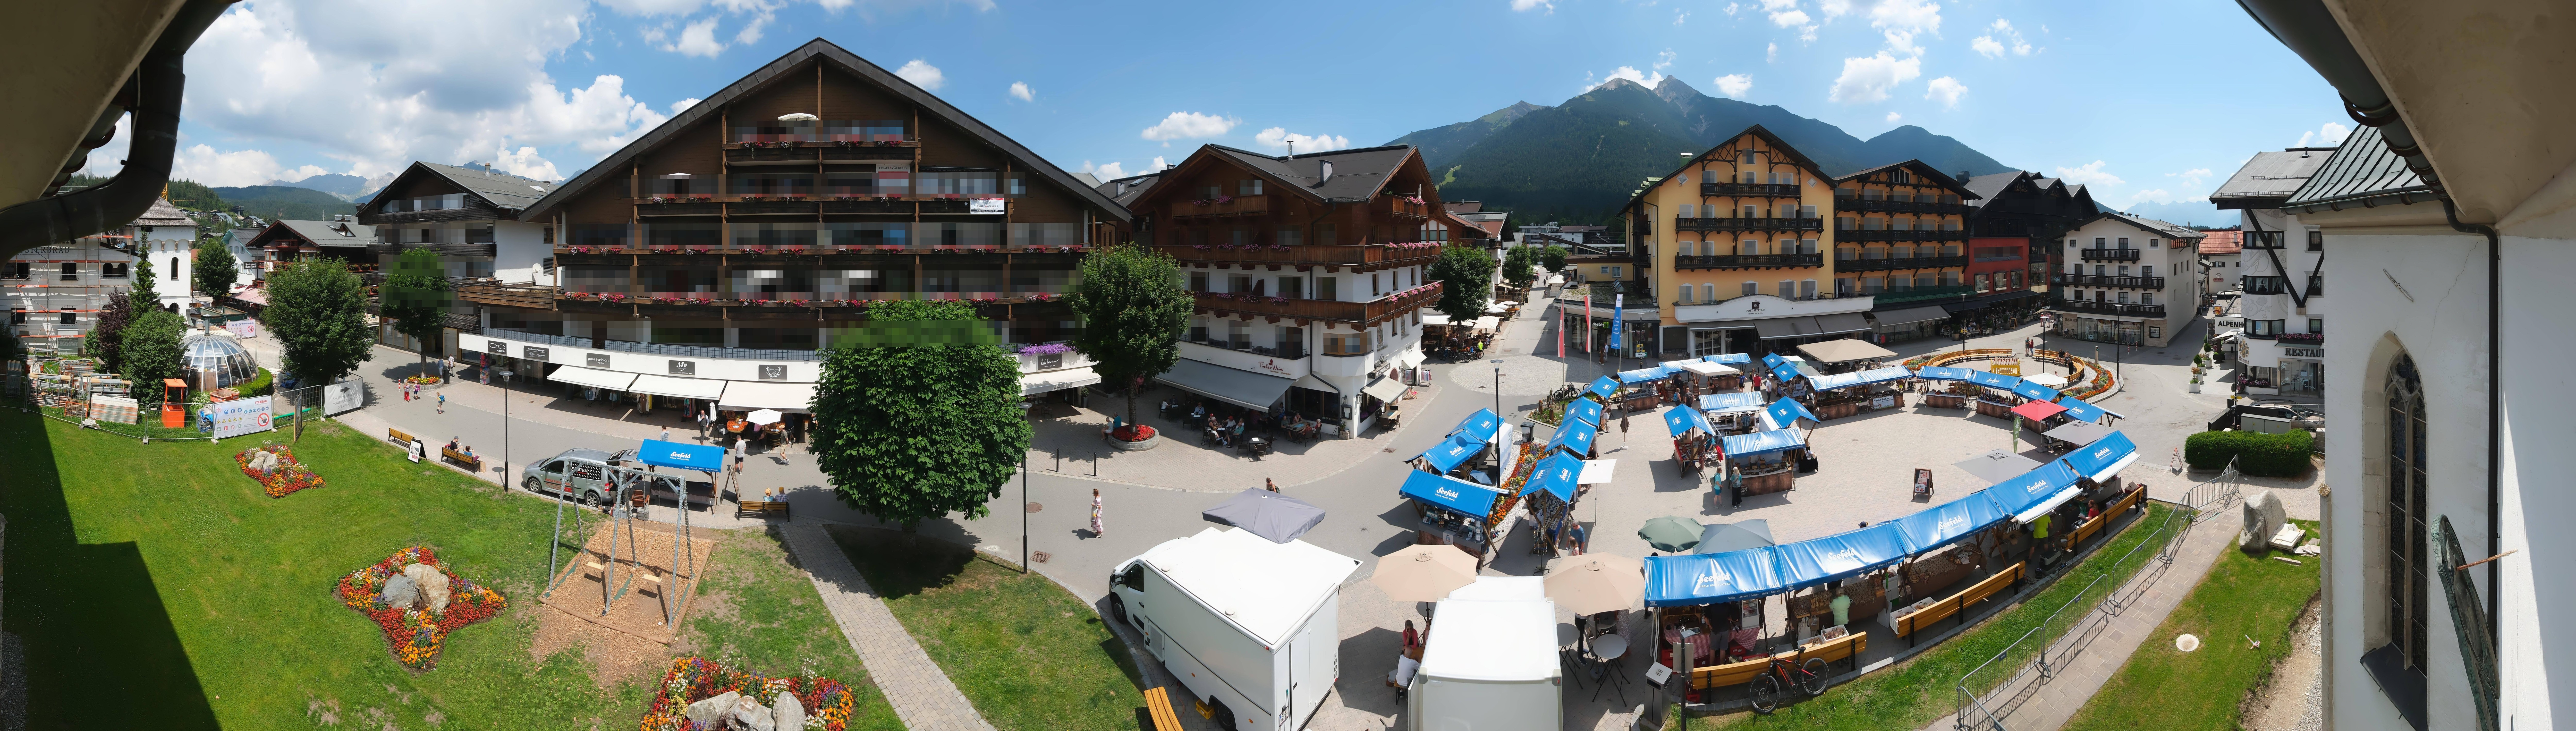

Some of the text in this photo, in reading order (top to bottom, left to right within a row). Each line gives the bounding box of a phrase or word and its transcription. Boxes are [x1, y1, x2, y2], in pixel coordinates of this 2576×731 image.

[1375, 364, 1390, 377] RESTAURANT
[1449, 446, 1463, 455] Seefeld
[2095, 447, 2110, 458] Seefeld
[2027, 479, 2046, 492] Seefeld
[1437, 487, 1459, 498] Seefeld
[1939, 515, 1963, 530] Seefeld
[1827, 547, 1855, 561] Seefeld
[1697, 573, 1730, 584] Seefeld
